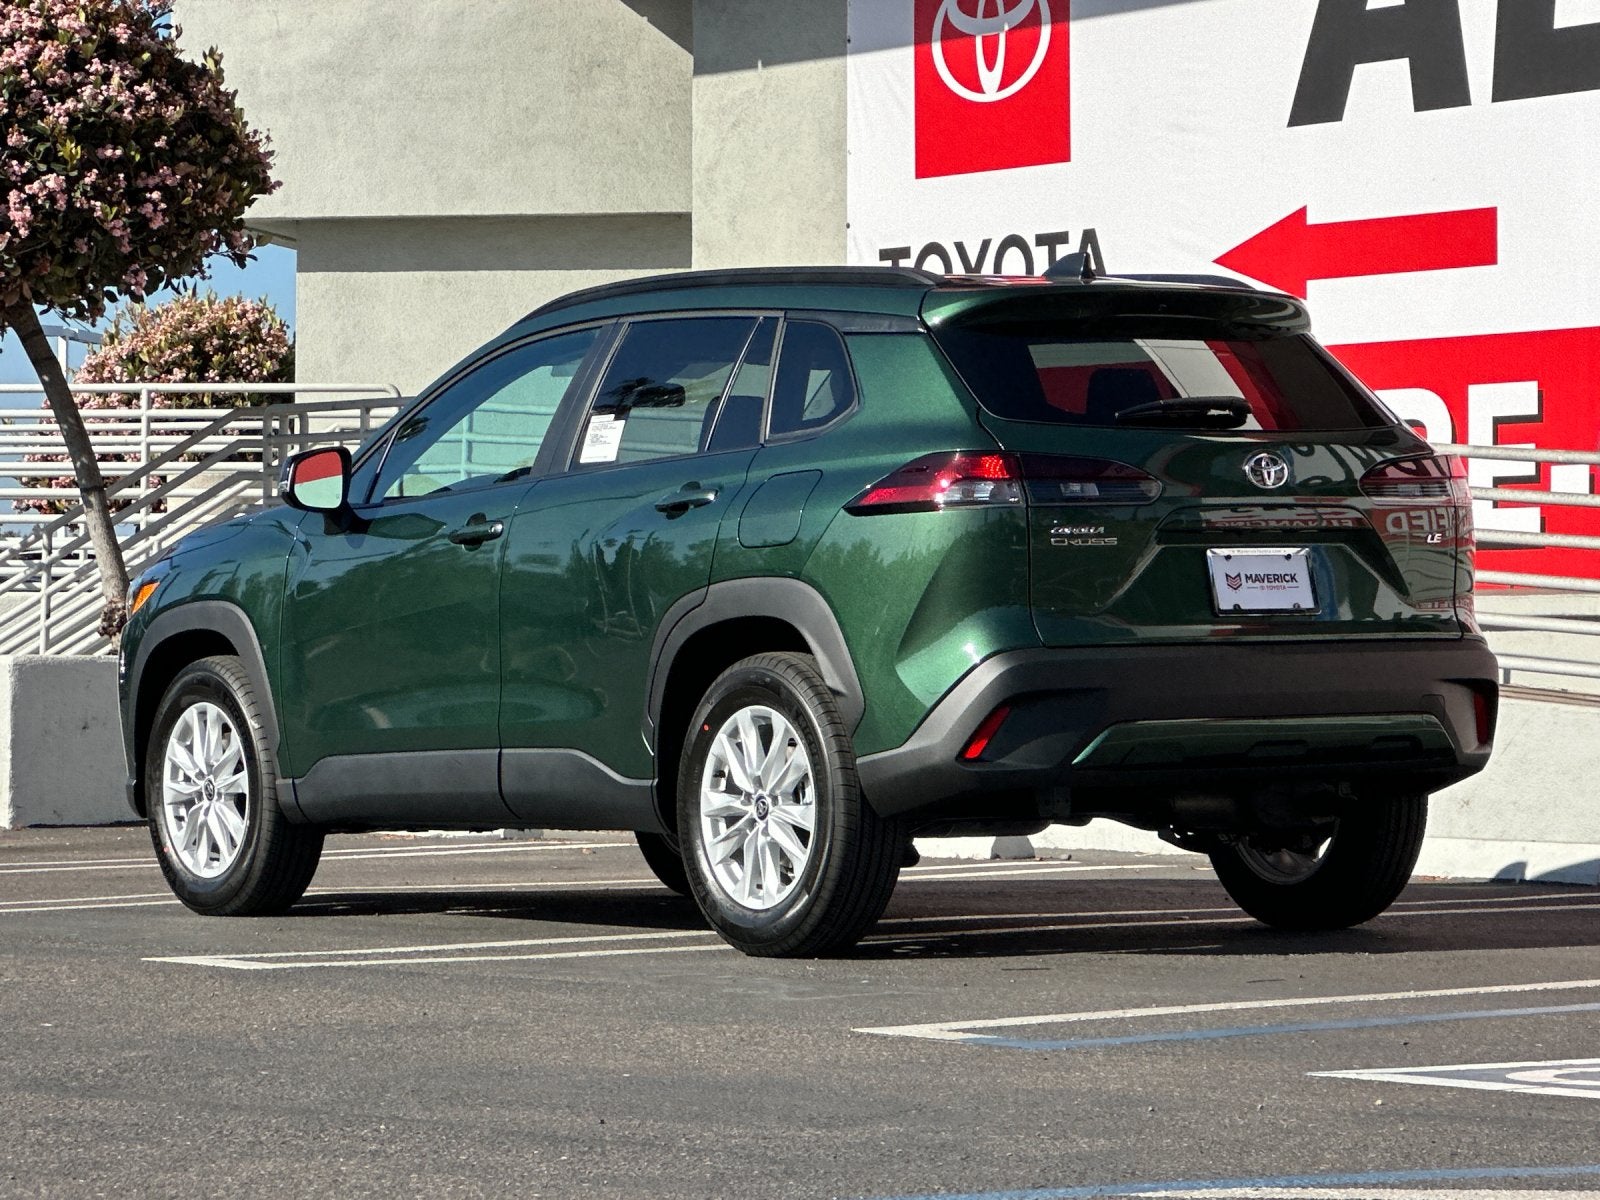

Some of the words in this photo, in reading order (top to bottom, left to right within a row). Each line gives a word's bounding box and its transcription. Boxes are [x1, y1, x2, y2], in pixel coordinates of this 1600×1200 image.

[1050, 537, 1118, 546] CROSS
[1427, 533, 1442, 543] LE
[1244, 573, 1298, 584] MAVERICK
